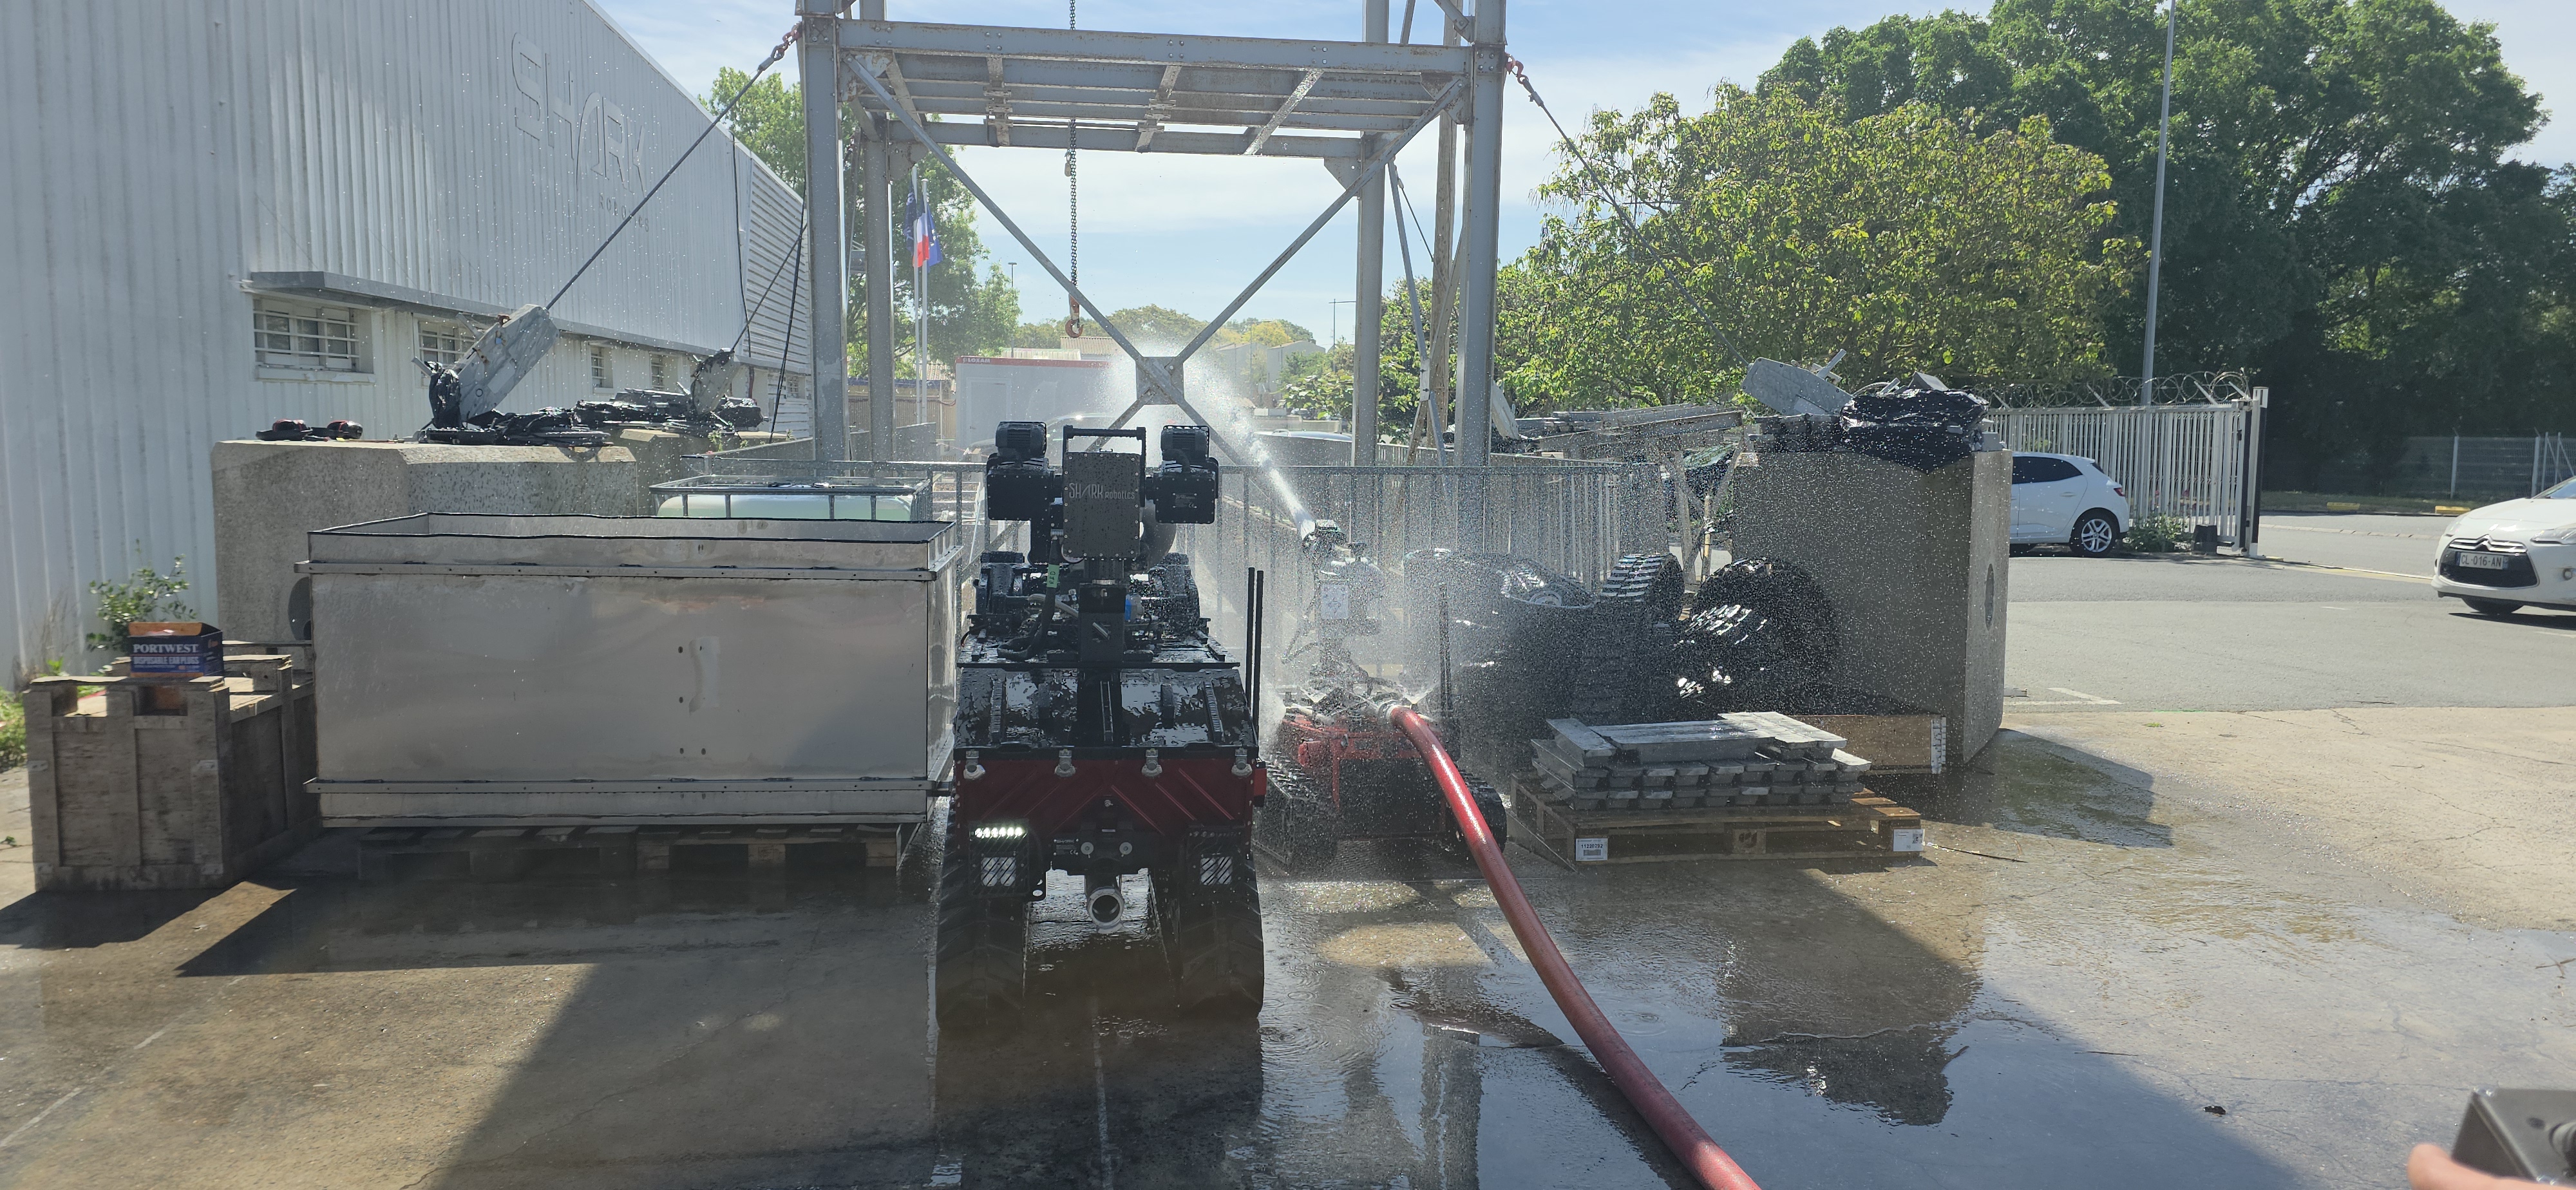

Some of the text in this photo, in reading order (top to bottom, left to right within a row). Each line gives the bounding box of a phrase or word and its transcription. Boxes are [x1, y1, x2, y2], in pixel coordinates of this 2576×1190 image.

[511, 32, 645, 198] SHARK
[1068, 482, 1103, 499] SHARK
[2461, 554, 2502, 567] CL-016-AN
[133, 644, 200, 653] PORTWEST
